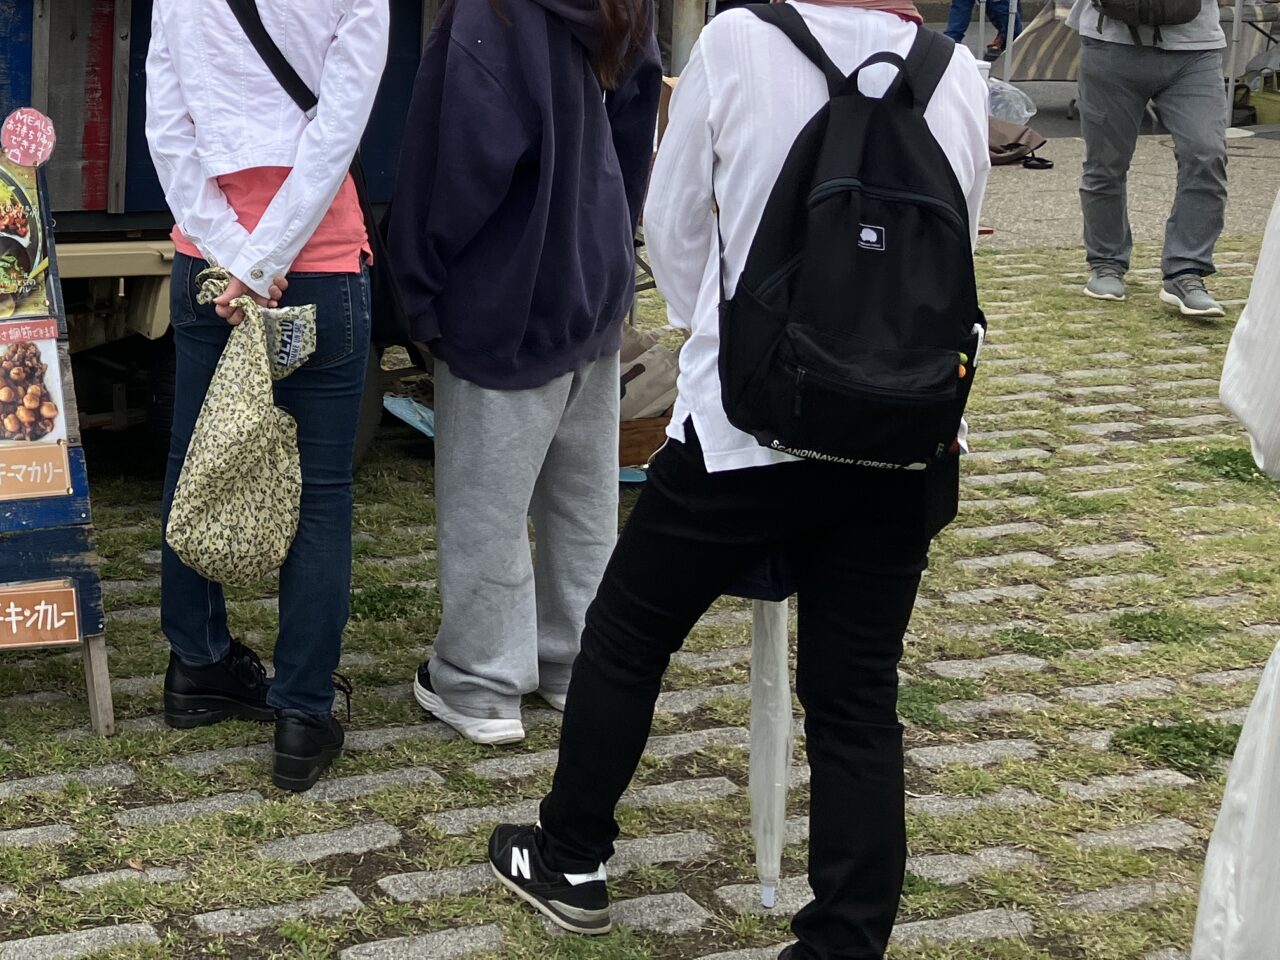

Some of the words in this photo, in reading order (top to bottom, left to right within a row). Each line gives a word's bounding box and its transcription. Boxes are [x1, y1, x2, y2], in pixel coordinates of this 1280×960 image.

[15, 111, 53, 135] MEALS
[10, 135, 45, 160] できます
[770, 439, 854, 465] SCANDINAVIAN
[856, 459, 902, 470] FOREST
[510, 846, 531, 880] N
